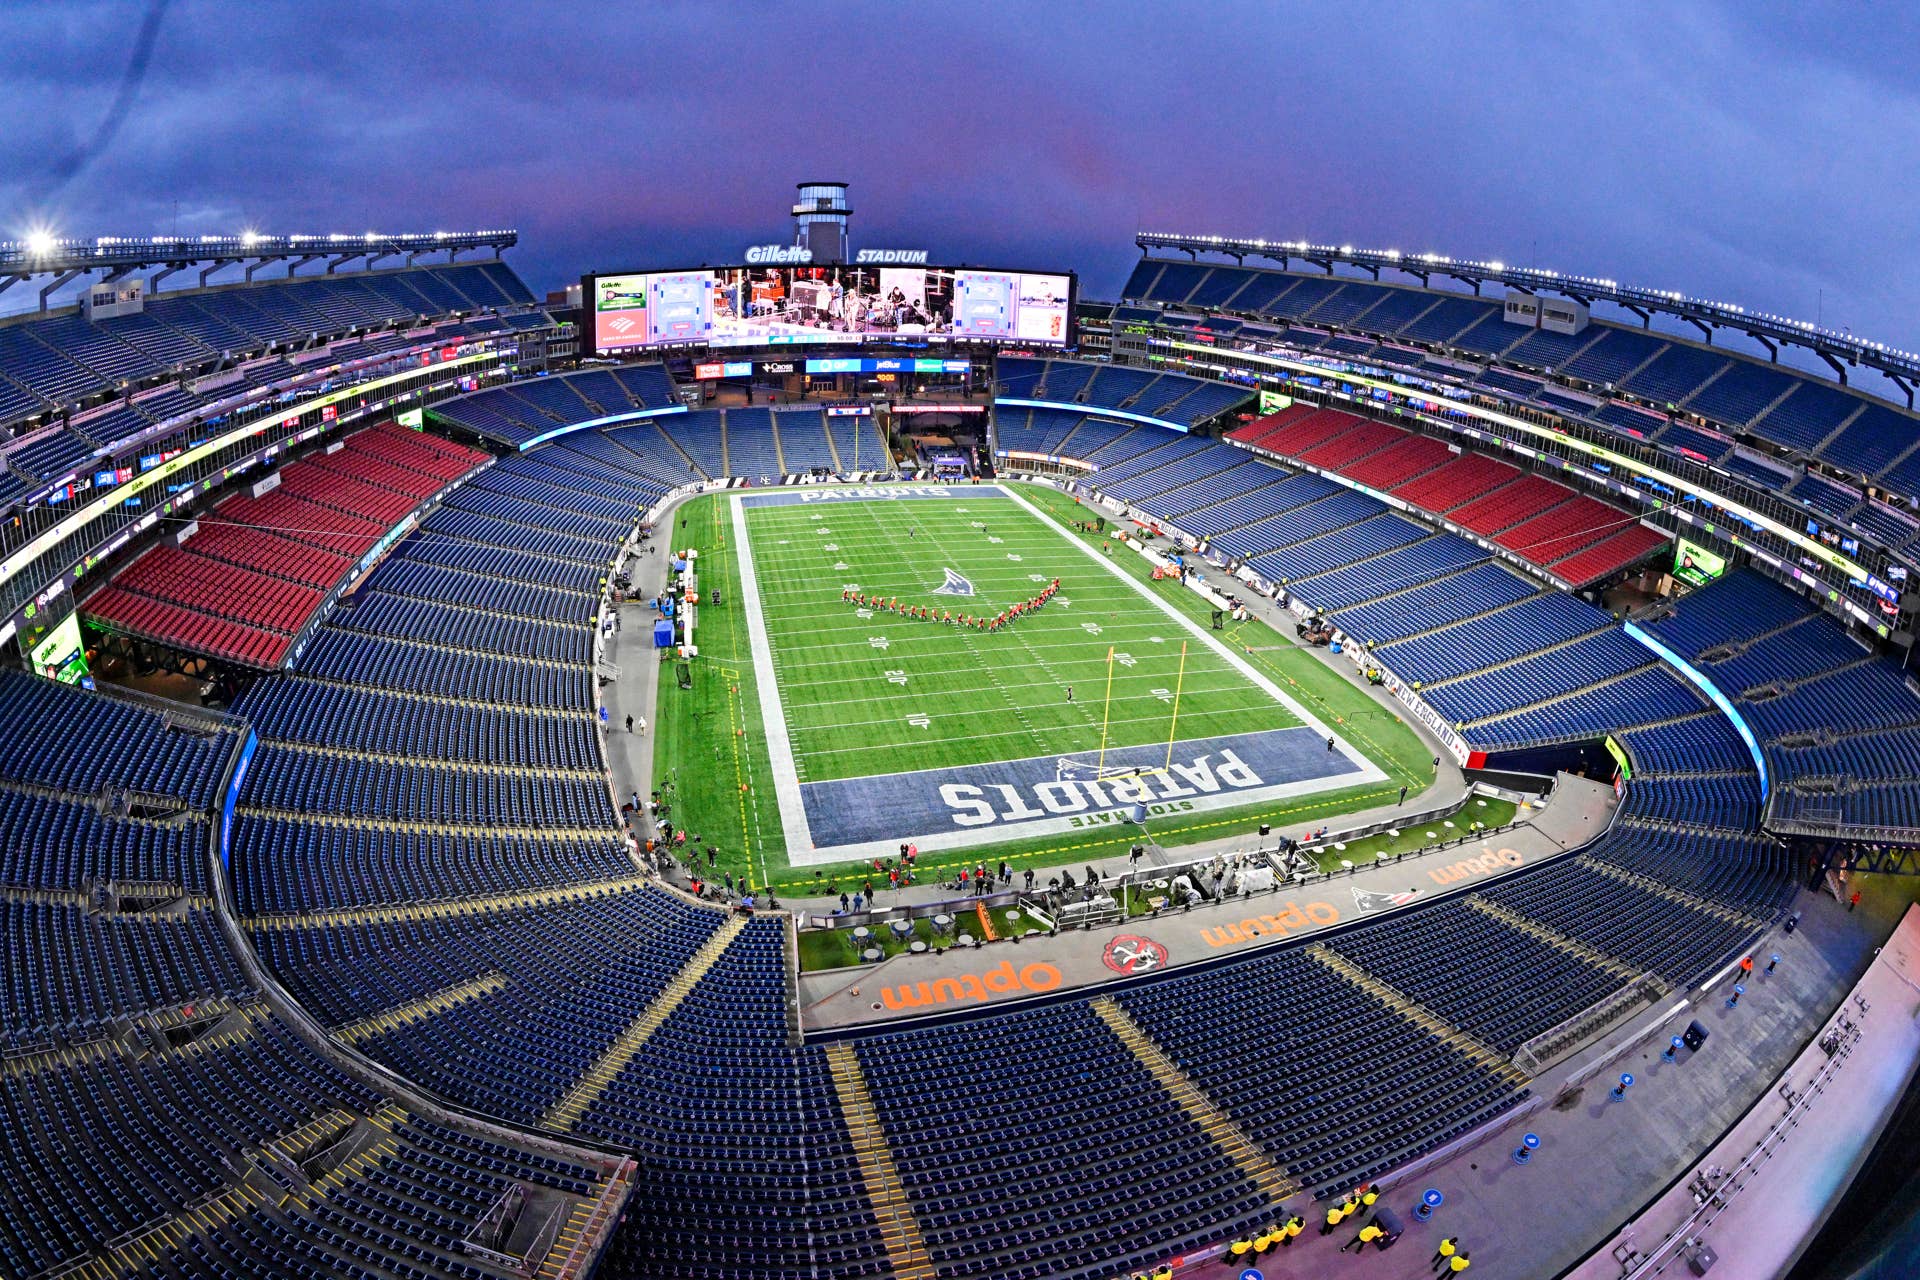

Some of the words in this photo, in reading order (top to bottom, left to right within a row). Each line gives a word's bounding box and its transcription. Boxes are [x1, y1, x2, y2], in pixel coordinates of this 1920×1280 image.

[745, 245, 812, 262] Gillette
[856, 249, 927, 263] STADIUM
[876, 361, 900, 370] jetBlue
[877, 374, 895, 382] 90:00
[800, 487, 952, 502] PATRIOTS
[1395, 683, 1416, 706] NEW
[1415, 701, 1455, 746] ENGLAND
[938, 748, 1264, 827] PATRIOTS
[1427, 848, 1524, 885] Optum
[1200, 902, 1339, 948] Optum
[880, 961, 1062, 1011] Optum
